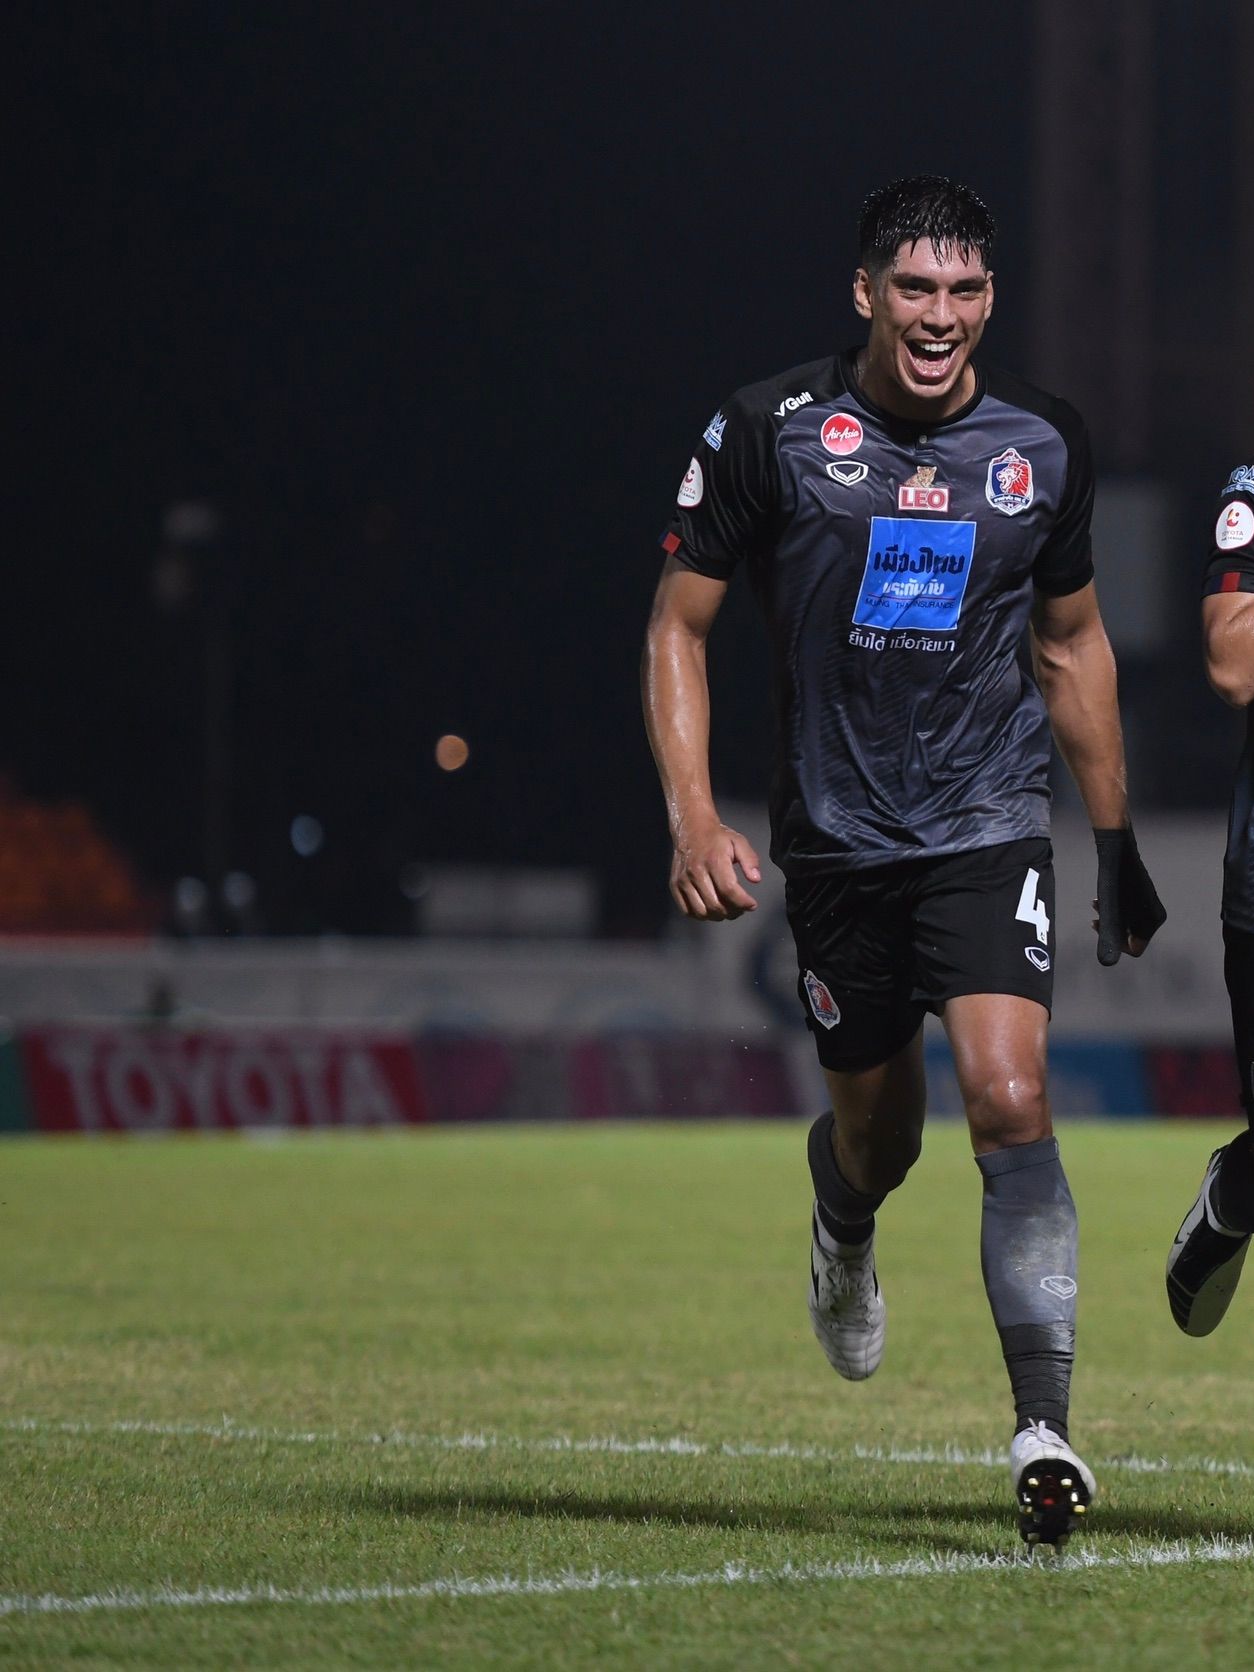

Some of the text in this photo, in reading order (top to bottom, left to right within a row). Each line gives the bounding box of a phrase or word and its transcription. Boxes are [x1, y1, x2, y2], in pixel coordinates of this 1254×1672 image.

[825, 427, 859, 442] AirAsia
[901, 489, 945, 508] LEO
[848, 627, 956, 652] ยิ้มได้ เมื่อภัยมา
[1015, 867, 1050, 945] 4
[47, 1038, 396, 1131] TOYOTA
